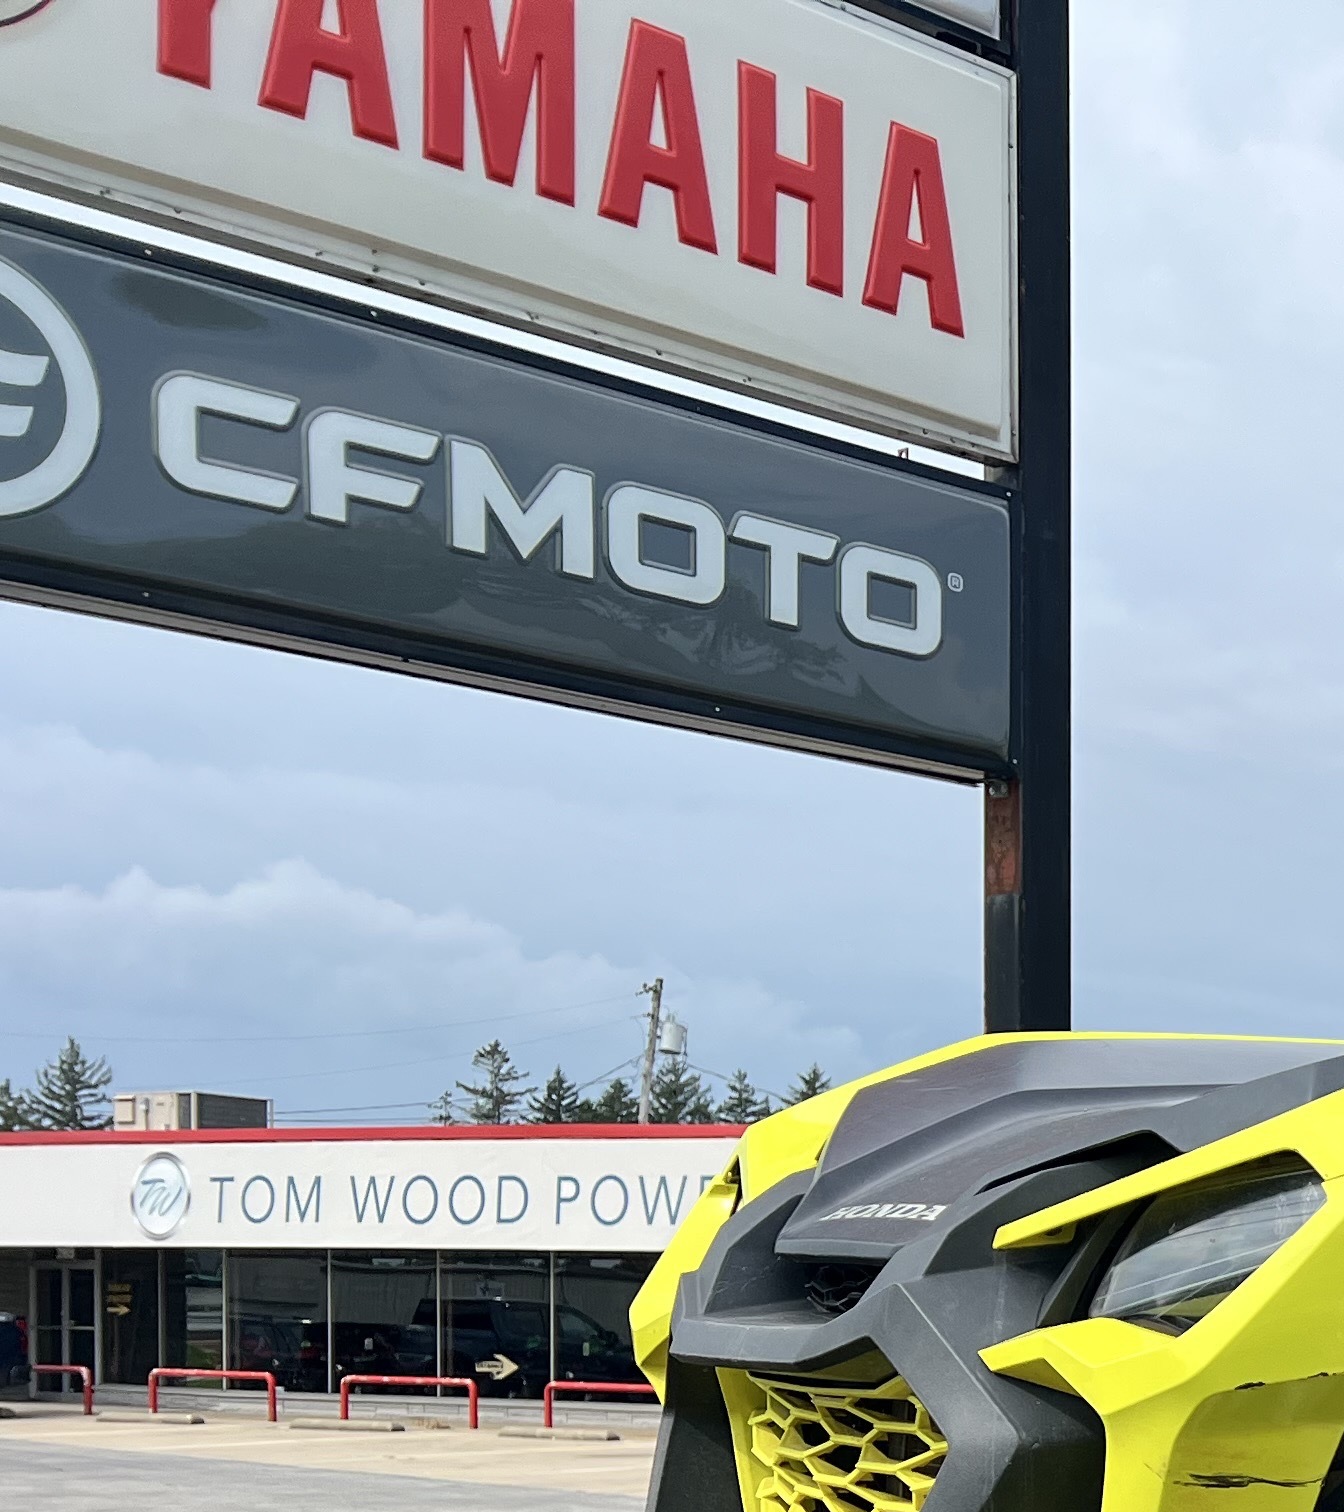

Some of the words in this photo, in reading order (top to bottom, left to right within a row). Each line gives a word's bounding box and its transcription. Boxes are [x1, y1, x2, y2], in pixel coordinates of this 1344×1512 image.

[209, 1175, 322, 1224] TOM
[350, 1174, 529, 1225] WOOD
[818, 1203, 949, 1221] HONDA
